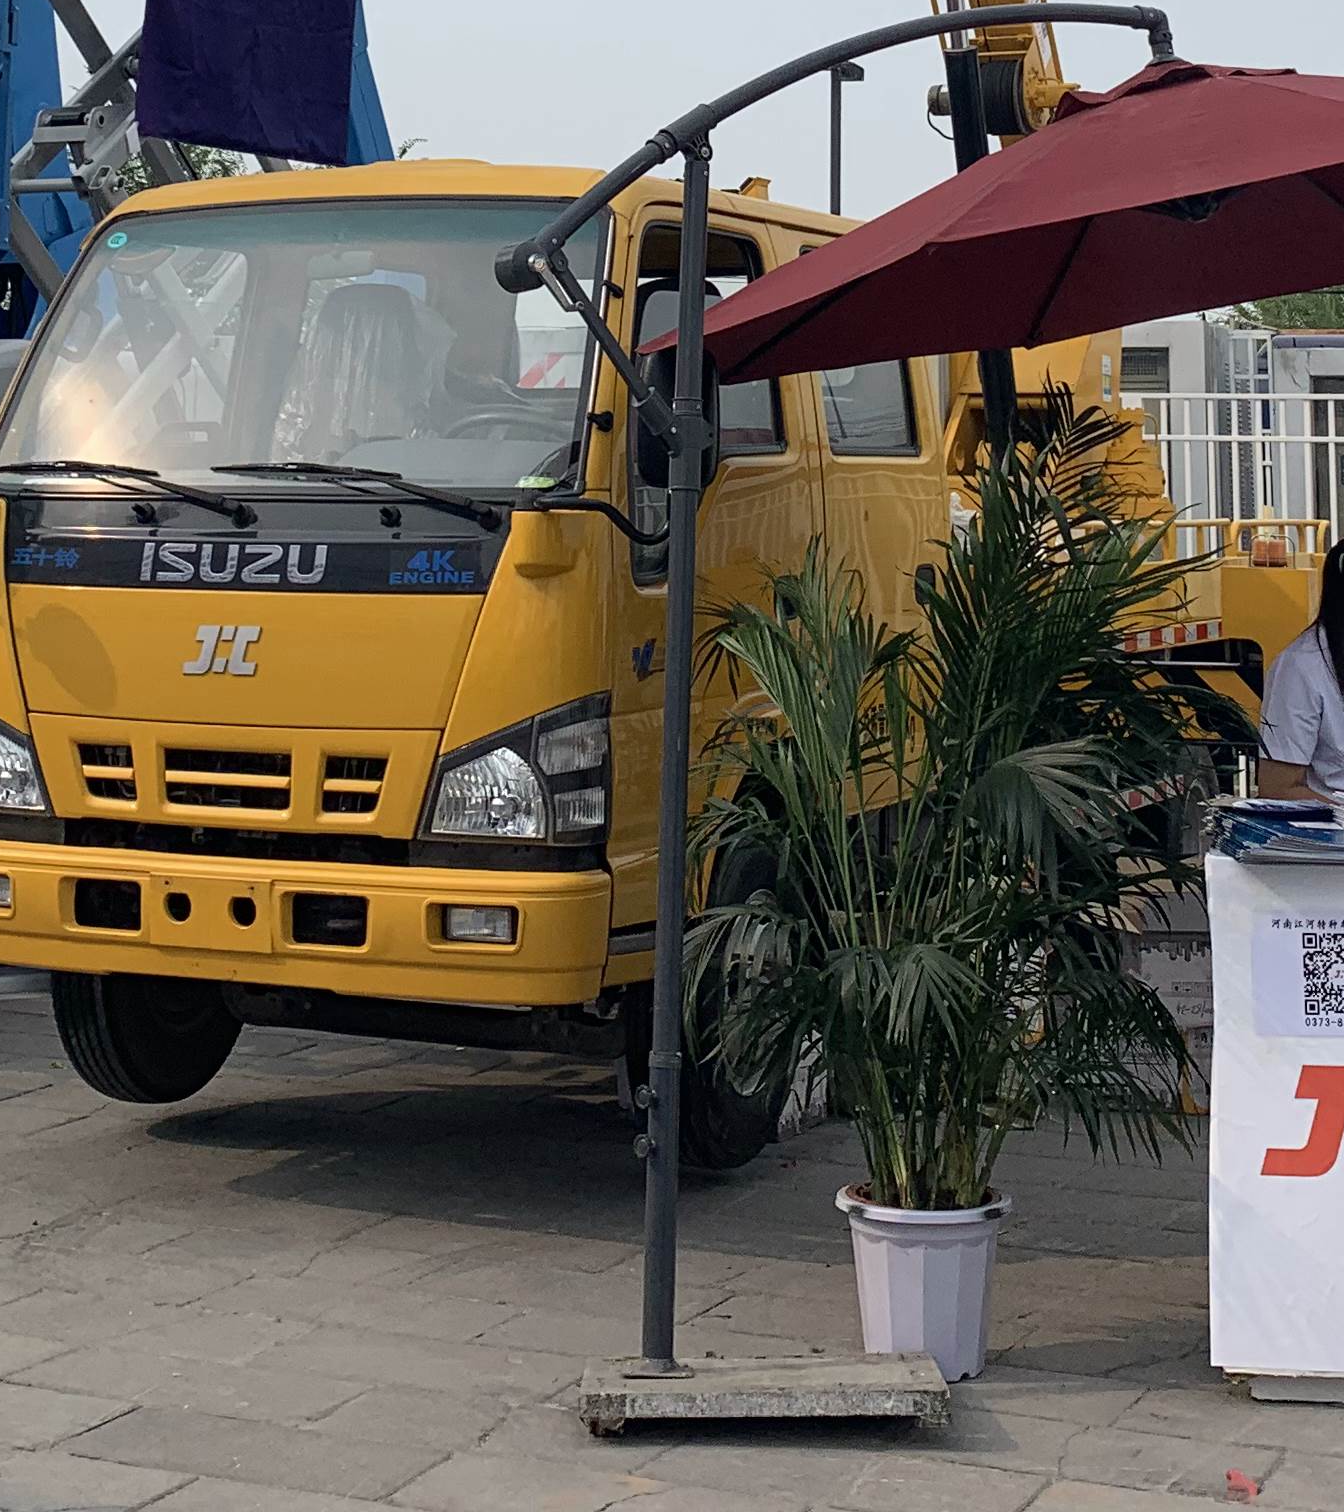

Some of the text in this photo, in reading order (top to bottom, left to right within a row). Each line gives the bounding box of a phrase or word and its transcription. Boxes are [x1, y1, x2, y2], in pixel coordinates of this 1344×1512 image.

[11, 547, 80, 569] 五十铃
[139, 541, 329, 584] ISUZU
[407, 550, 455, 572] 4K
[388, 570, 475, 585] ENGINE
